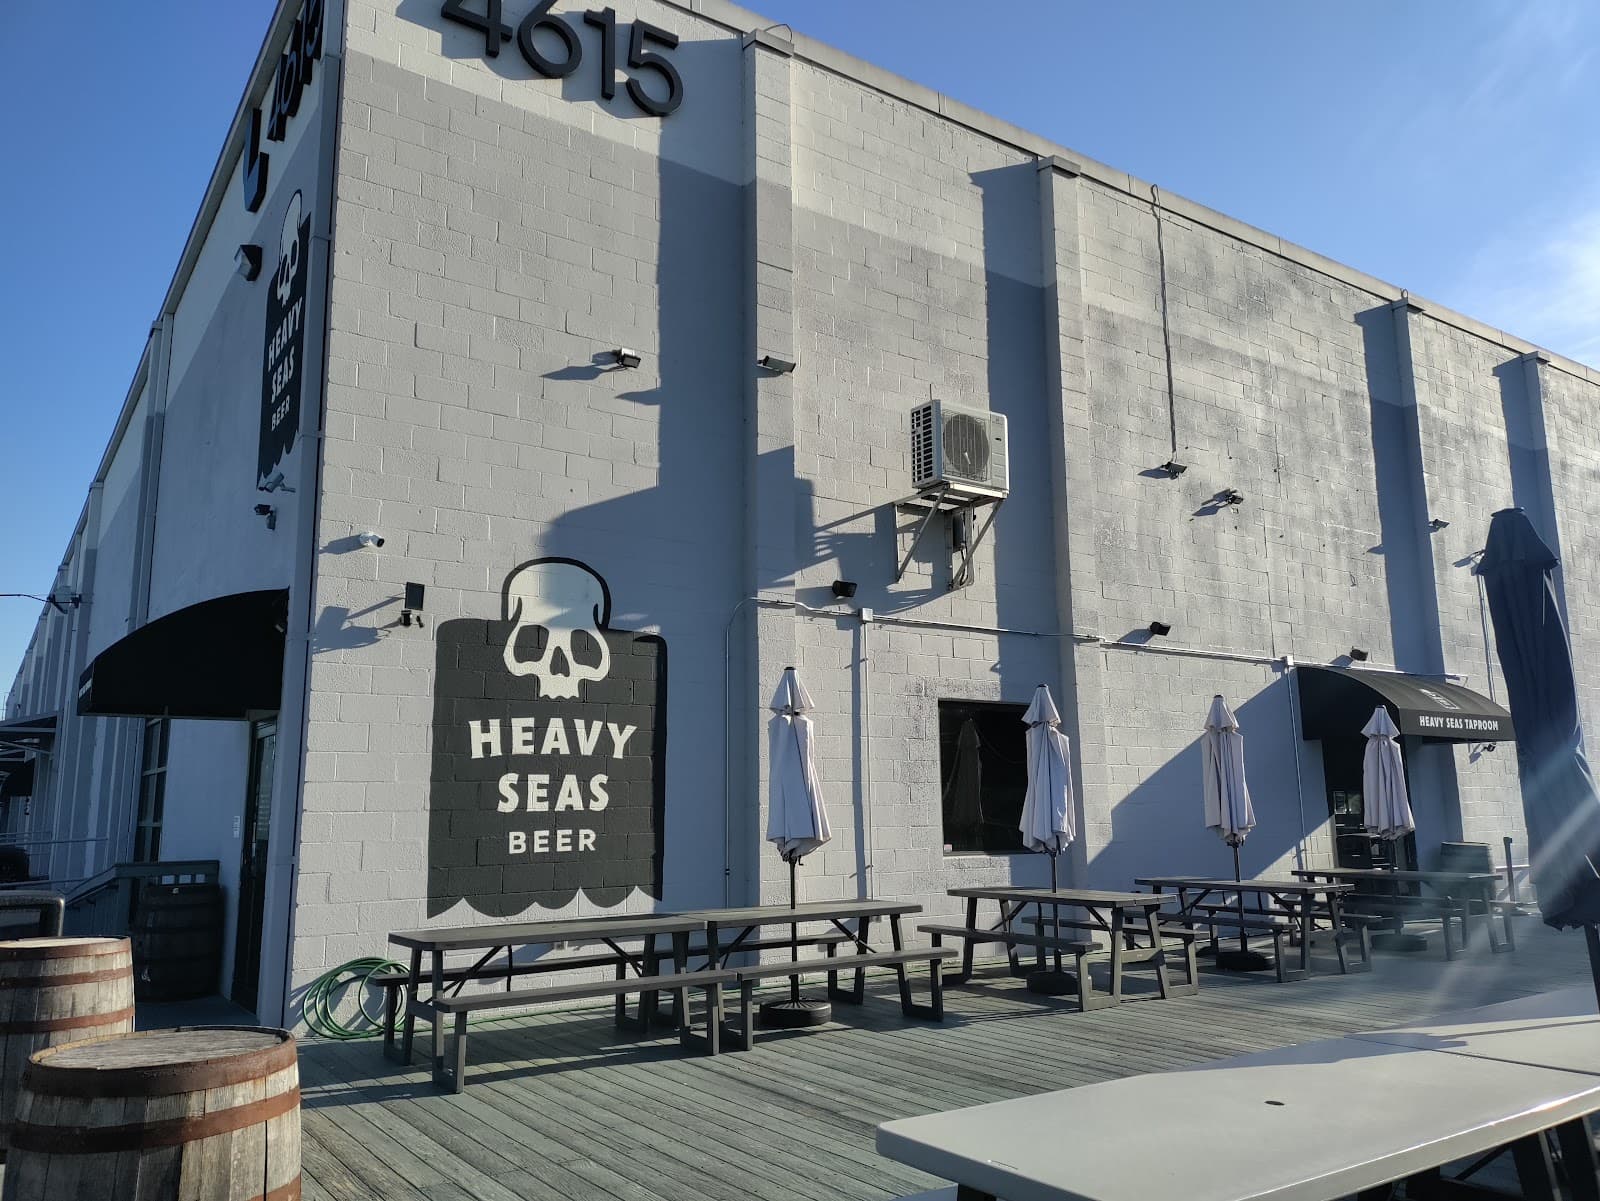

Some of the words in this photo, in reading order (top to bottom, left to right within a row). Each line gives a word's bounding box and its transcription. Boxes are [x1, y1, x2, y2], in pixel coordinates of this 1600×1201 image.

[441, 0, 683, 117] 4615
[268, 296, 302, 372] HEAVY
[271, 345, 294, 404] SEAS
[271, 395, 290, 431] BEER
[468, 717, 638, 759] HEAVY
[1419, 715, 1444, 728] HEAVY
[1446, 717, 1463, 729] SEAS
[1465, 719, 1499, 731] TAPROOM
[497, 773, 609, 813] SEAS
[508, 829, 597, 854] BEER
